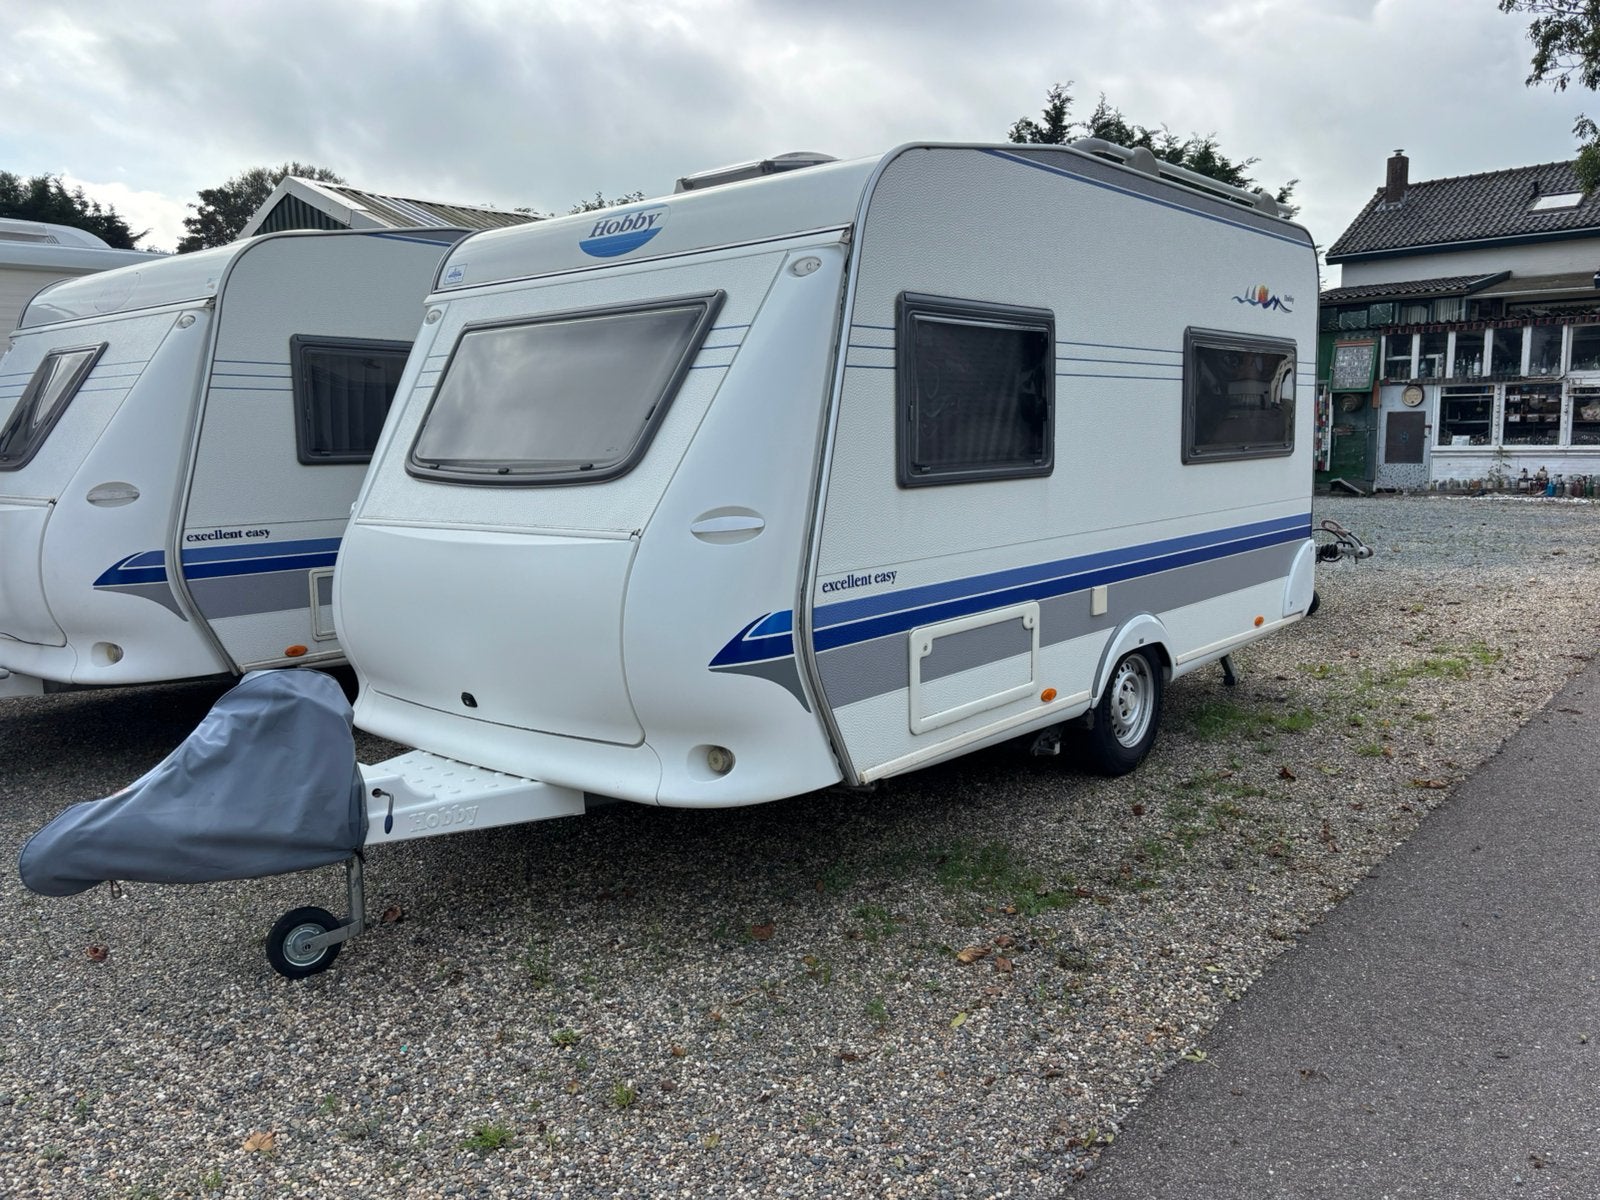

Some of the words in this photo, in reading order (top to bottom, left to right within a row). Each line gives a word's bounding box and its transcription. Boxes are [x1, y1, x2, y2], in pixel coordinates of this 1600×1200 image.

[588, 211, 662, 238] Hobby
[186, 529, 242, 542] excellent
[245, 528, 271, 539] easy
[822, 573, 872, 593] excellent
[874, 570, 898, 585] easy
